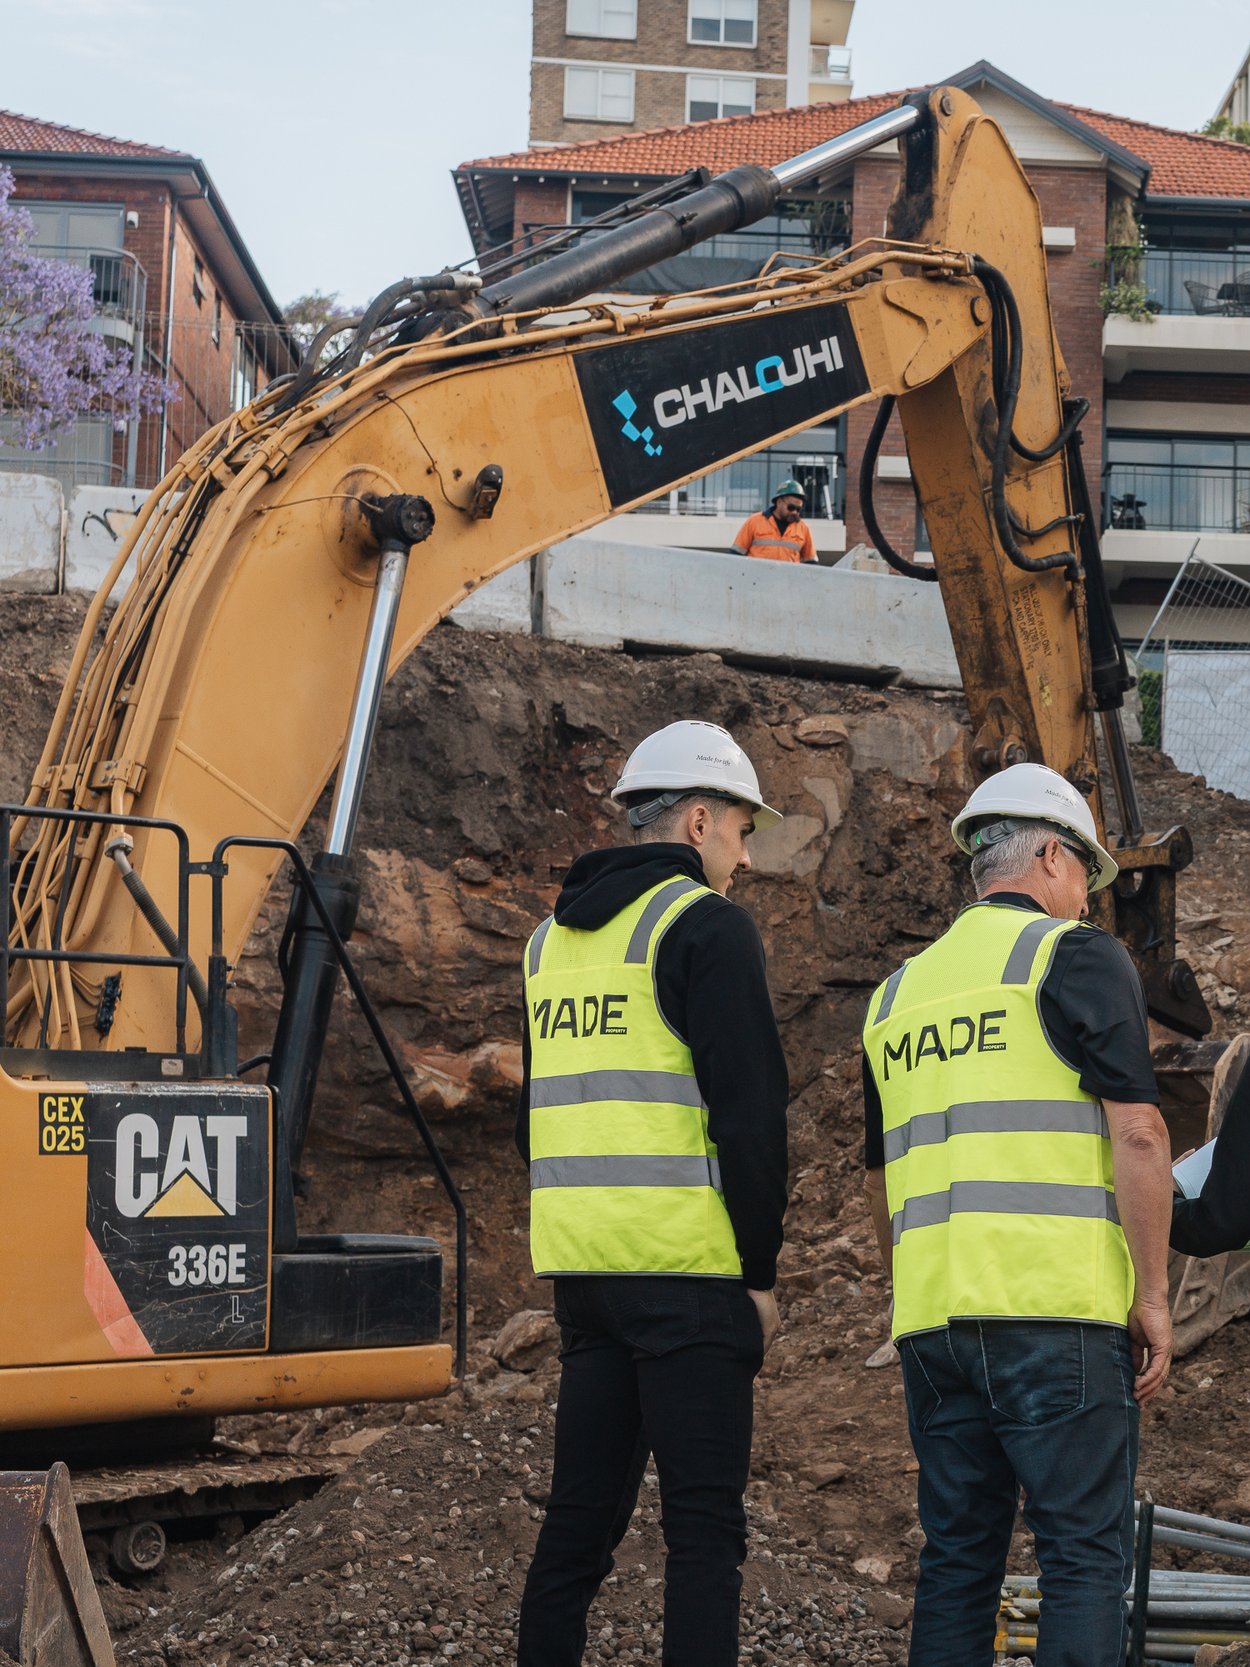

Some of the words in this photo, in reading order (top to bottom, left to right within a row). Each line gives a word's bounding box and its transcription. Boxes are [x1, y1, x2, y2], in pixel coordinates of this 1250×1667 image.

[653, 335, 844, 428] CHALOUHI
[1014, 606, 1024, 621] AND
[1020, 585, 1036, 626] STATIONARY
[1042, 639, 1052, 657] ONLY
[884, 1009, 1007, 1082] MADE
[43, 1096, 85, 1123] CEX
[42, 1126, 85, 1152] 025
[115, 1113, 248, 1218] CAT
[168, 1243, 247, 1287] 336E
[231, 1295, 245, 1323] L
